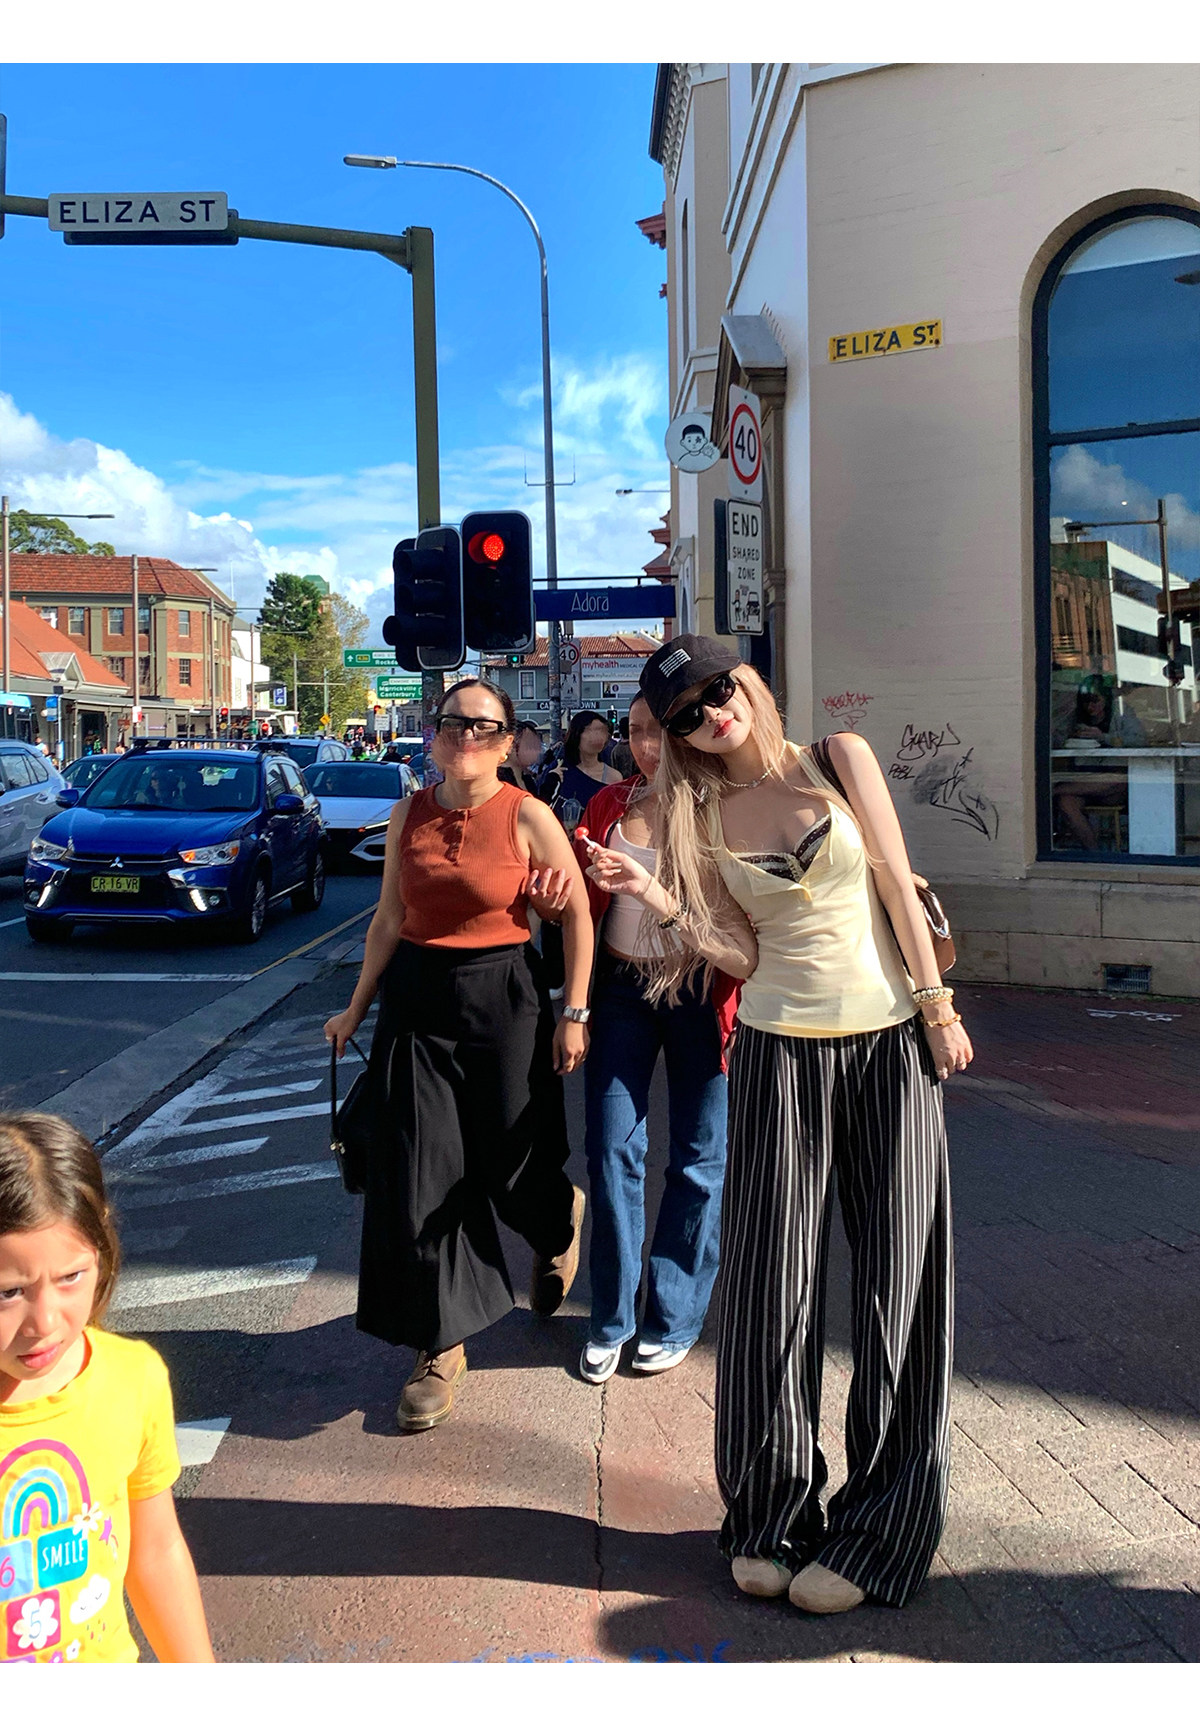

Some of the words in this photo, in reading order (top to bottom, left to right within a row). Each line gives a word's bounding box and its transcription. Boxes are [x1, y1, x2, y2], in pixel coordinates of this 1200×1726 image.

[60, 201, 159, 223] ELIZA
[179, 200, 215, 223] ST
[836, 330, 902, 358] ELIZA
[735, 425, 757, 462] 40
[732, 512, 759, 537] END
[732, 546, 760, 562] SHARED
[738, 567, 756, 580] ZONE
[571, 592, 609, 612] Adora
[560, 649, 577, 661] 40
[582, 661, 619, 670] myhealth
[93, 877, 106, 889] CR
[111, 877, 122, 889] 16
[126, 877, 138, 889] VR
[42, 1537, 85, 1571] SMILE
[0, 1556, 15, 1588] 6
[29, 1609, 42, 1639] 5
